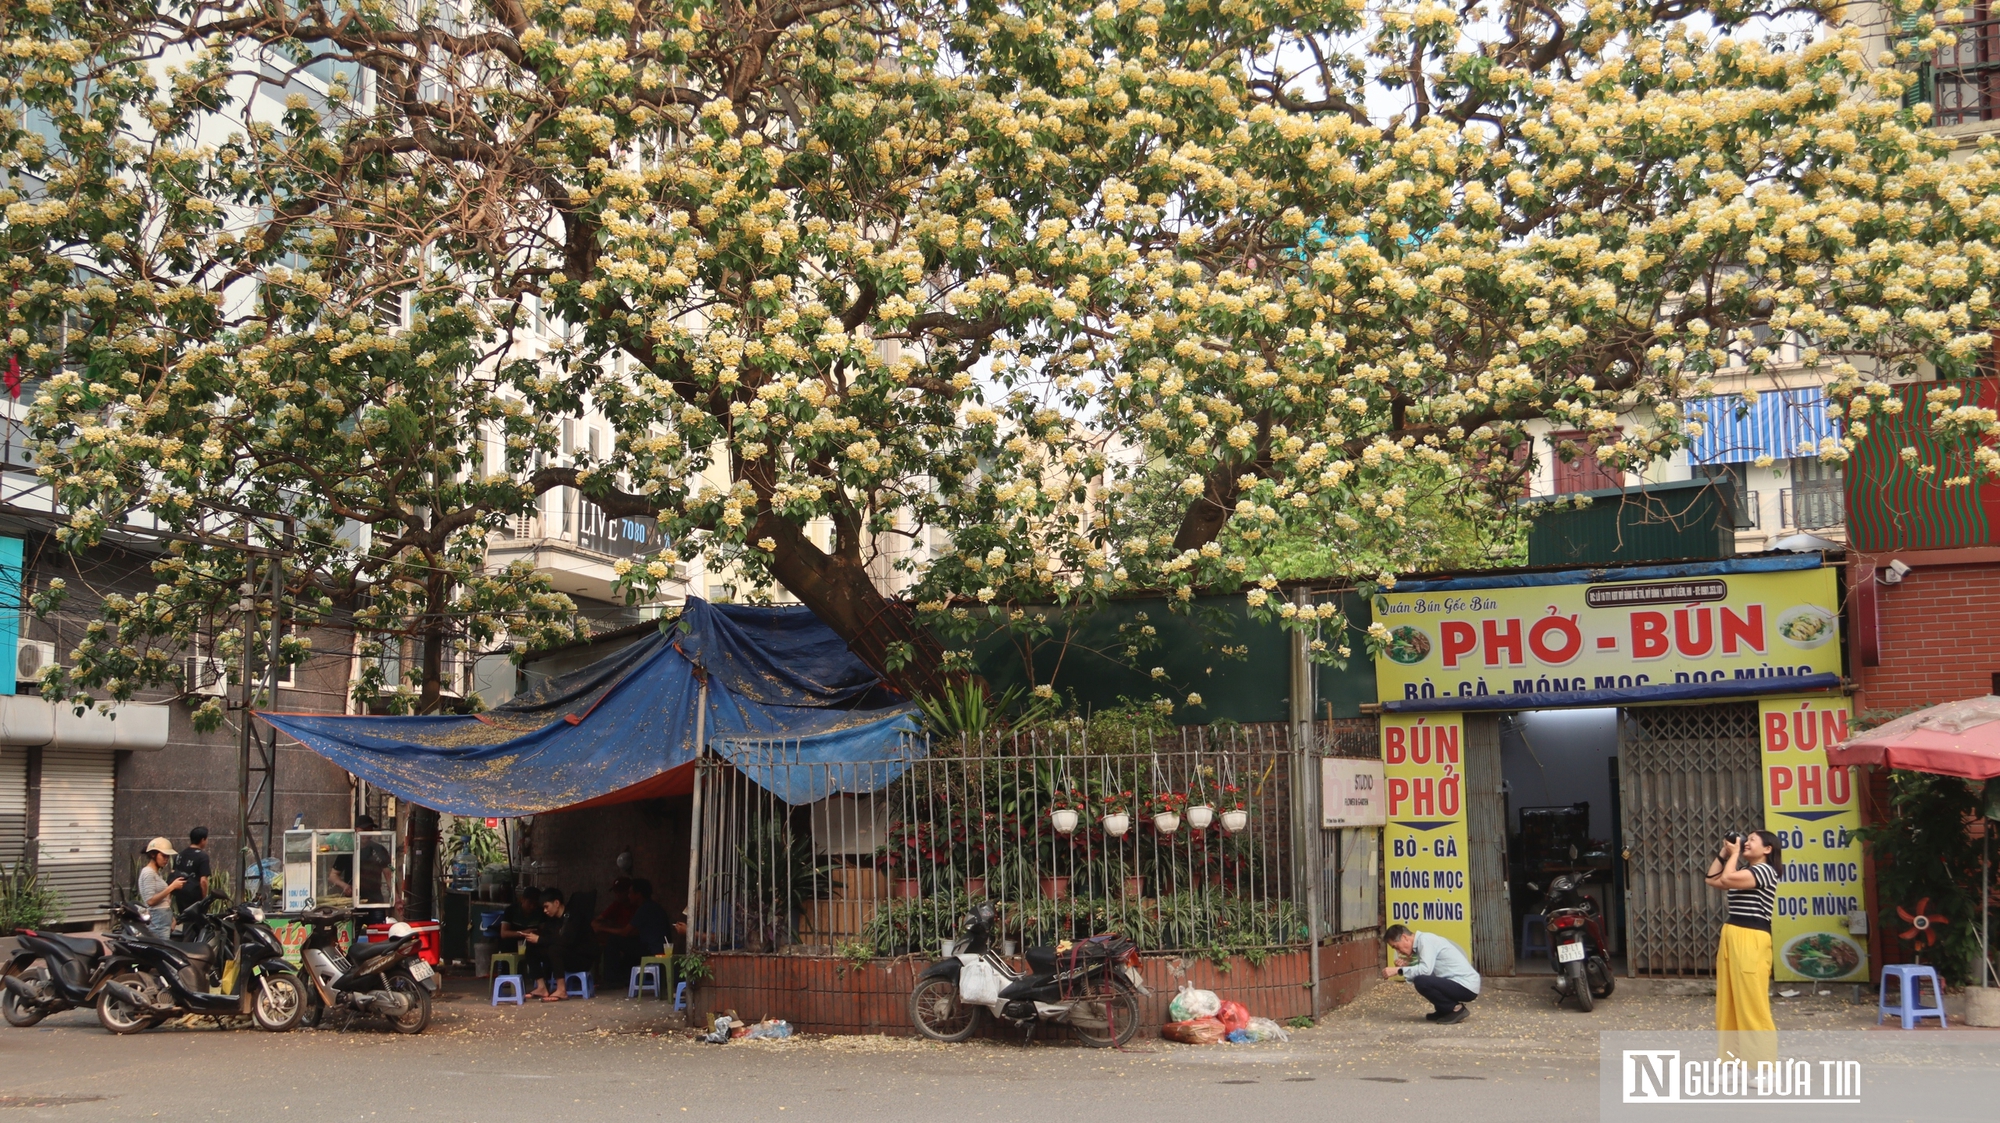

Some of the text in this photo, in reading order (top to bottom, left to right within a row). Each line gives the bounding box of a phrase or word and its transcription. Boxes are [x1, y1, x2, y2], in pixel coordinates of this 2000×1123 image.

[622, 518, 646, 544] 7080
[1414, 599, 1441, 614] Bún
[1444, 597, 1466, 614] Gốc
[1470, 596, 1497, 611] Bún
[1440, 605, 1582, 667] PHỞ
[1630, 602, 1765, 659] BÚN
[1404, 677, 1435, 700] BÒ
[1459, 676, 1489, 697] GÀ
[1765, 702, 1849, 752] BÚN
[1385, 717, 1459, 765] BÚN
[1388, 764, 1460, 816] PHỞ
[1393, 835, 1417, 858] BÒ
[1434, 835, 1458, 858] GÀ
[1777, 825, 1803, 849] BÒ
[1823, 825, 1850, 848] GÀ
[1390, 867, 1463, 893] MÓNG MỌC
[1823, 862, 1857, 886] MỌC
[1393, 898, 1463, 924] DỌC MÙNG
[1778, 892, 1858, 920] DỌC MÙNG
